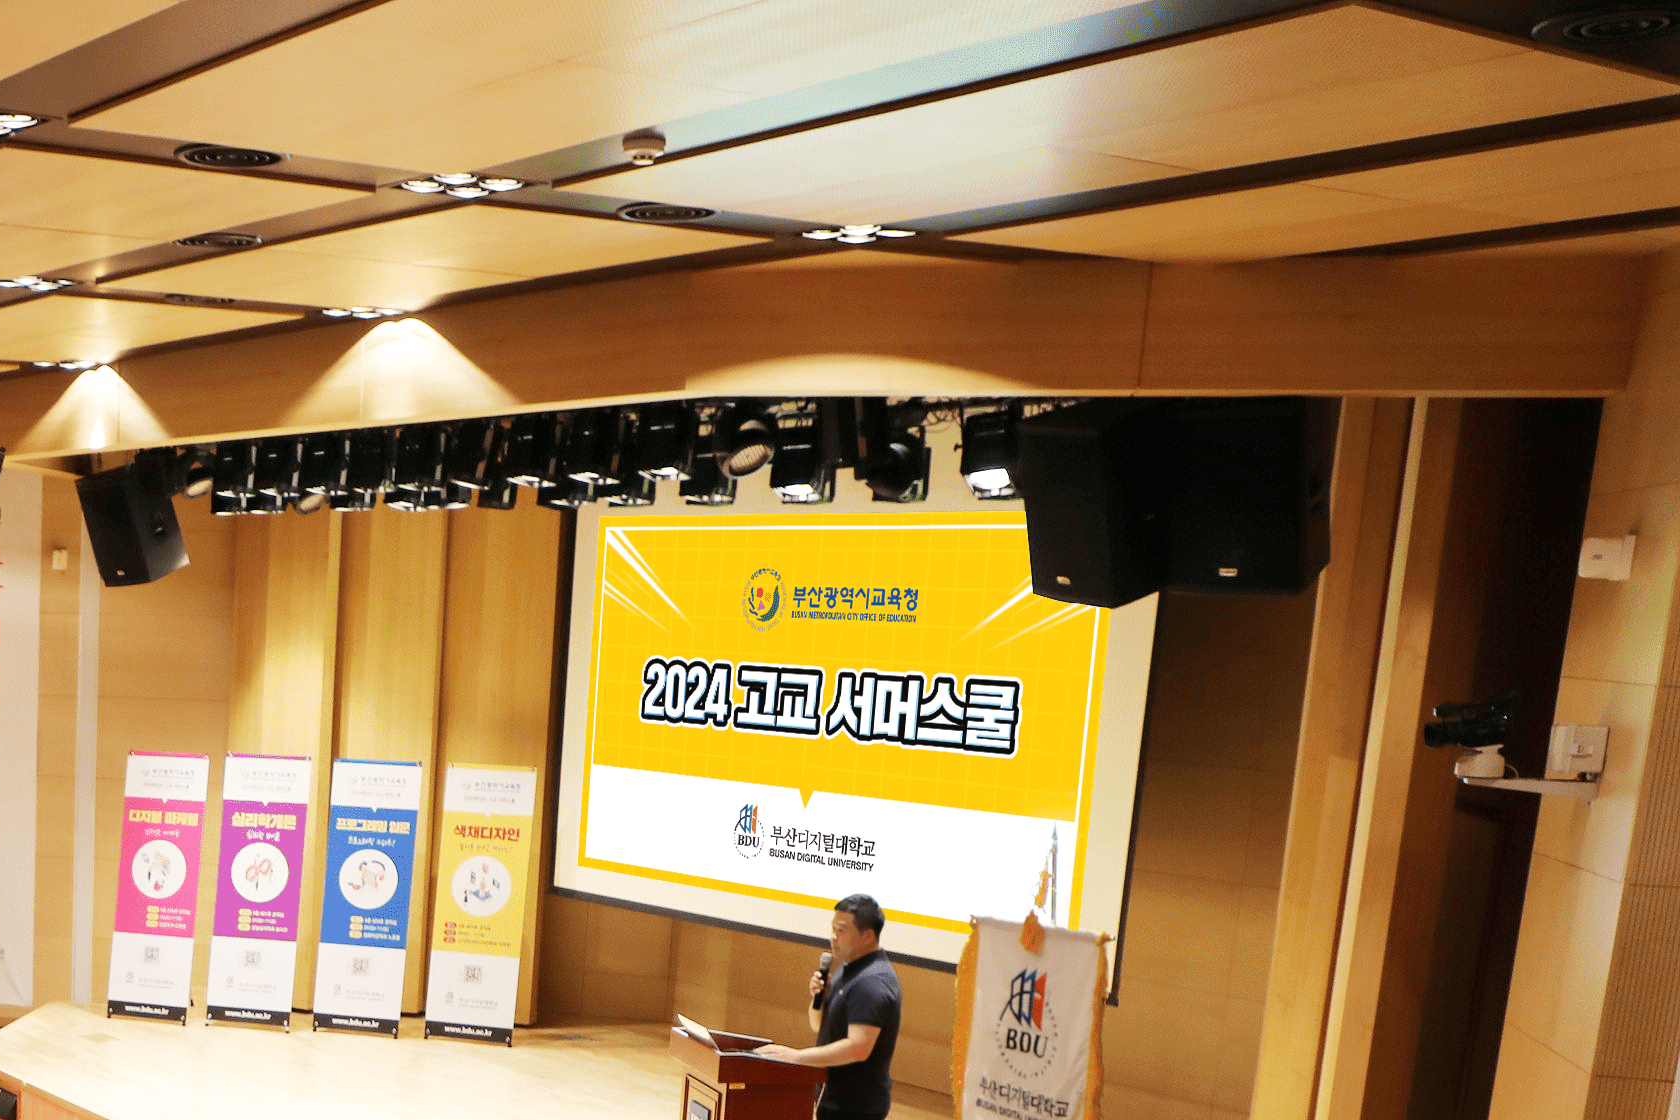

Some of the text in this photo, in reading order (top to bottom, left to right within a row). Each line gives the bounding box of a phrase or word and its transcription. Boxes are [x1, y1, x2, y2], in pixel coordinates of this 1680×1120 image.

[792, 586, 919, 612] 부산광역시교육청
[791, 610, 917, 623] BUSAN METROPOLITAN CITY OFFICE OF EDUCATION
[642, 659, 1020, 754] 2024 고교 서머스쿨
[453, 824, 521, 842] 색채디자인
[737, 834, 760, 848] BDU
[770, 826, 876, 857] 부산디지털대학교
[769, 848, 874, 872] BUSAN DIGITAL UNIVERSITY
[1006, 1028, 1049, 1058] BDU
